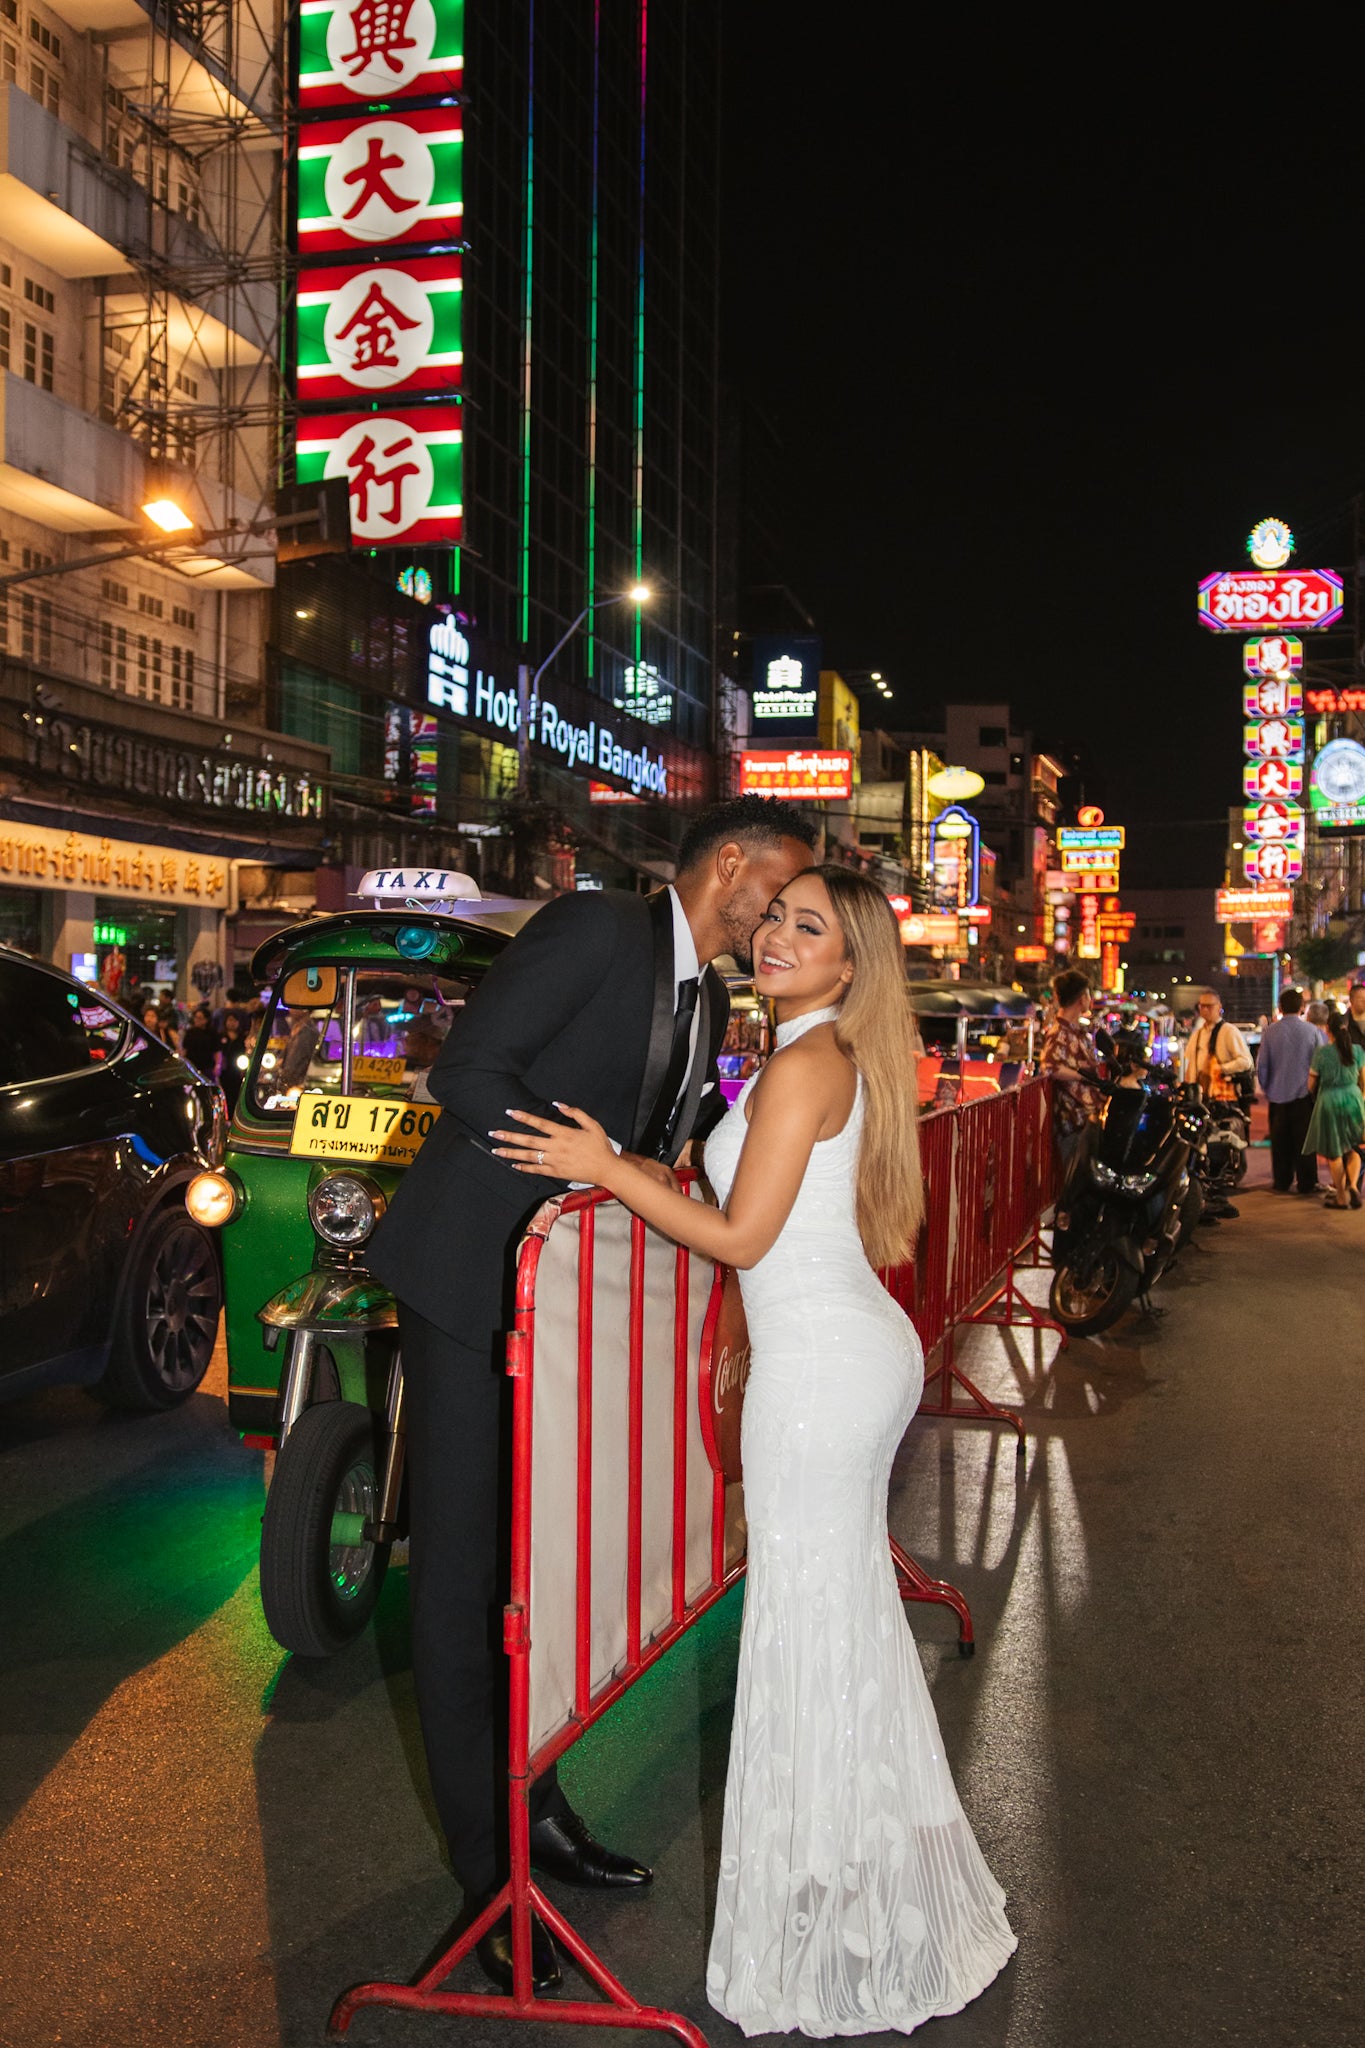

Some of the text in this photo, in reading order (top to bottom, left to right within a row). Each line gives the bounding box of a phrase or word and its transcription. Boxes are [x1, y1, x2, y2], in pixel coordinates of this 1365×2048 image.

[1213, 578, 1329, 621] ทองใบ
[475, 669, 536, 741] Hotl
[541, 701, 596, 768] Royal
[598, 728, 667, 796] Bangkok
[375, 871, 450, 890] TAXI
[311, 1100, 434, 1137] สข 1760
